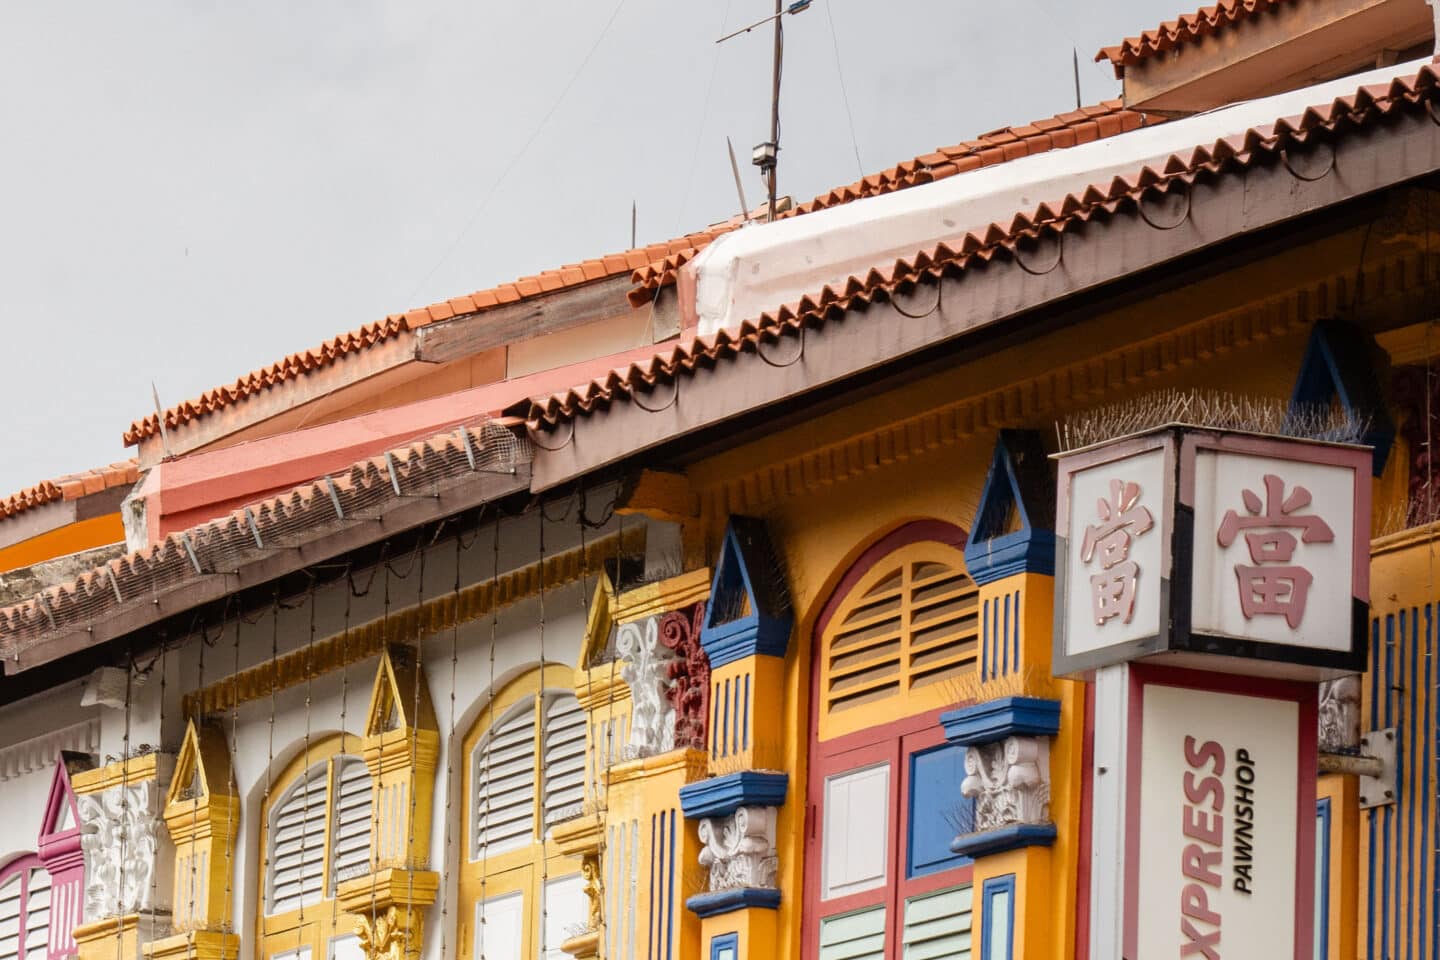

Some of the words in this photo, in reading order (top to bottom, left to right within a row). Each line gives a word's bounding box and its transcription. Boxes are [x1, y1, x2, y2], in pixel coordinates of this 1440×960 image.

[1080, 477, 1154, 627] 當
[1217, 473, 1335, 629] 當
[1234, 747, 1256, 895] PAWNSHOP
